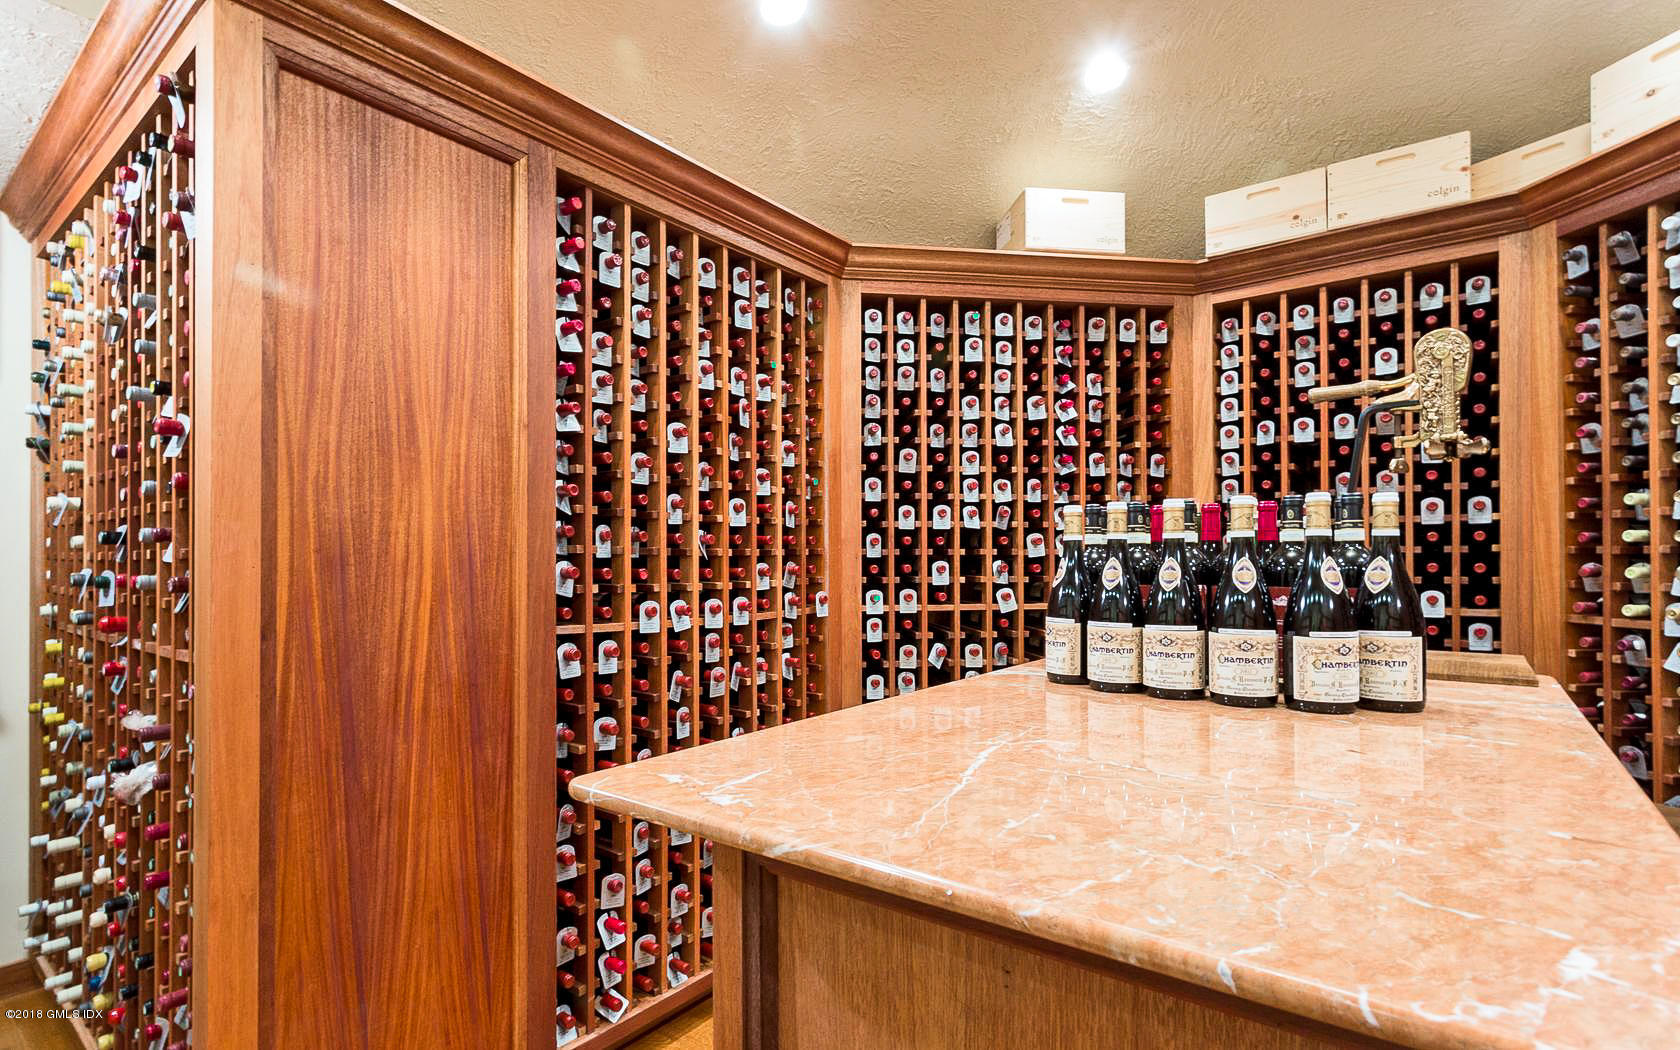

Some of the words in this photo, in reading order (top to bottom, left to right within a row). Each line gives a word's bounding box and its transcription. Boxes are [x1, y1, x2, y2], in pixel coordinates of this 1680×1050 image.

[1427, 184, 1459, 199] colgin
[1145, 648, 1195, 660] CHAMBERTIN
[1217, 653, 1274, 665] CHAMBERTIN
